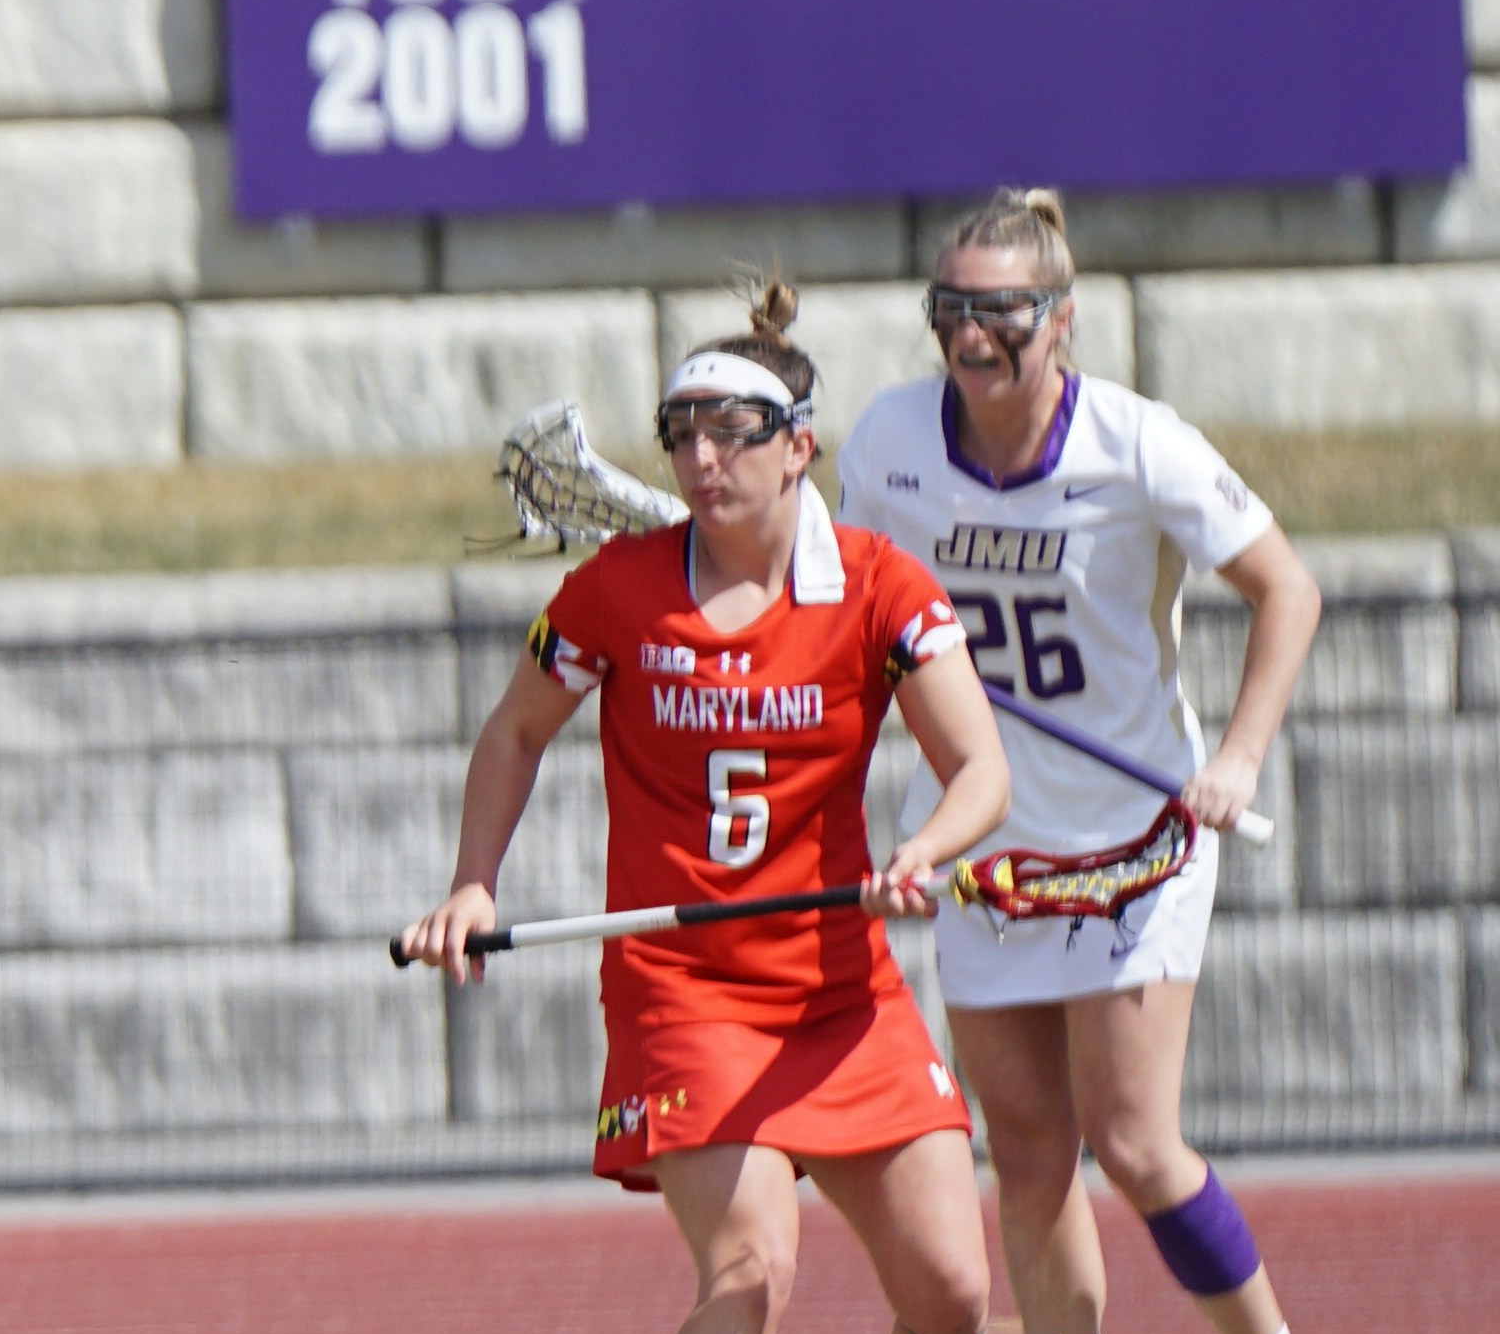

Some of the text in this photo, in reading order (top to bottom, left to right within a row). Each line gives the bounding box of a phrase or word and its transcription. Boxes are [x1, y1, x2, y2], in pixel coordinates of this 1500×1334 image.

[306, 2, 590, 153] 2001
[934, 523, 1067, 574] JMU
[948, 591, 1086, 700] 26
[653, 683, 824, 733] MARYLAND
[708, 748, 771, 870] 6
